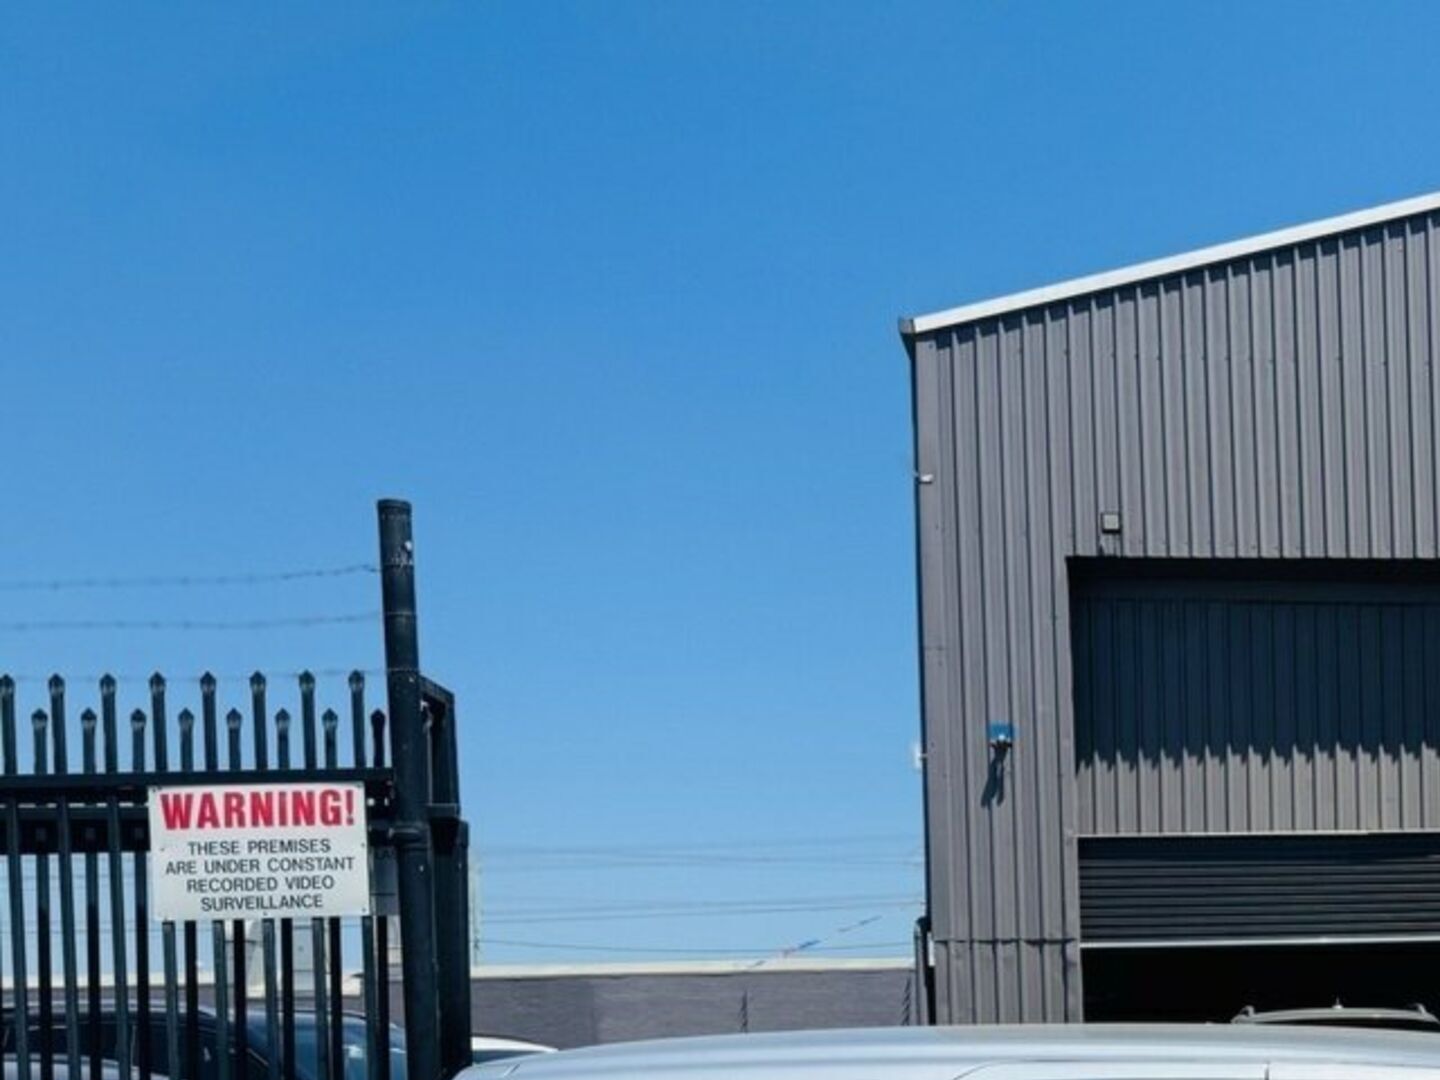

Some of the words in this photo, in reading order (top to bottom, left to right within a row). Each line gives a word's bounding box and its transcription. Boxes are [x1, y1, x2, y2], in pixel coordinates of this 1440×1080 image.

[160, 790, 354, 830] WARNING!
[188, 841, 241, 855] THESE
[247, 839, 331, 853] PREMISES
[166, 861, 197, 874] ARE
[204, 859, 260, 873] UNDER
[267, 857, 355, 872] CONSTANT
[187, 878, 277, 893] RECORDED
[285, 876, 334, 890] VIDEO
[201, 895, 323, 911] SURVEILLANCE
